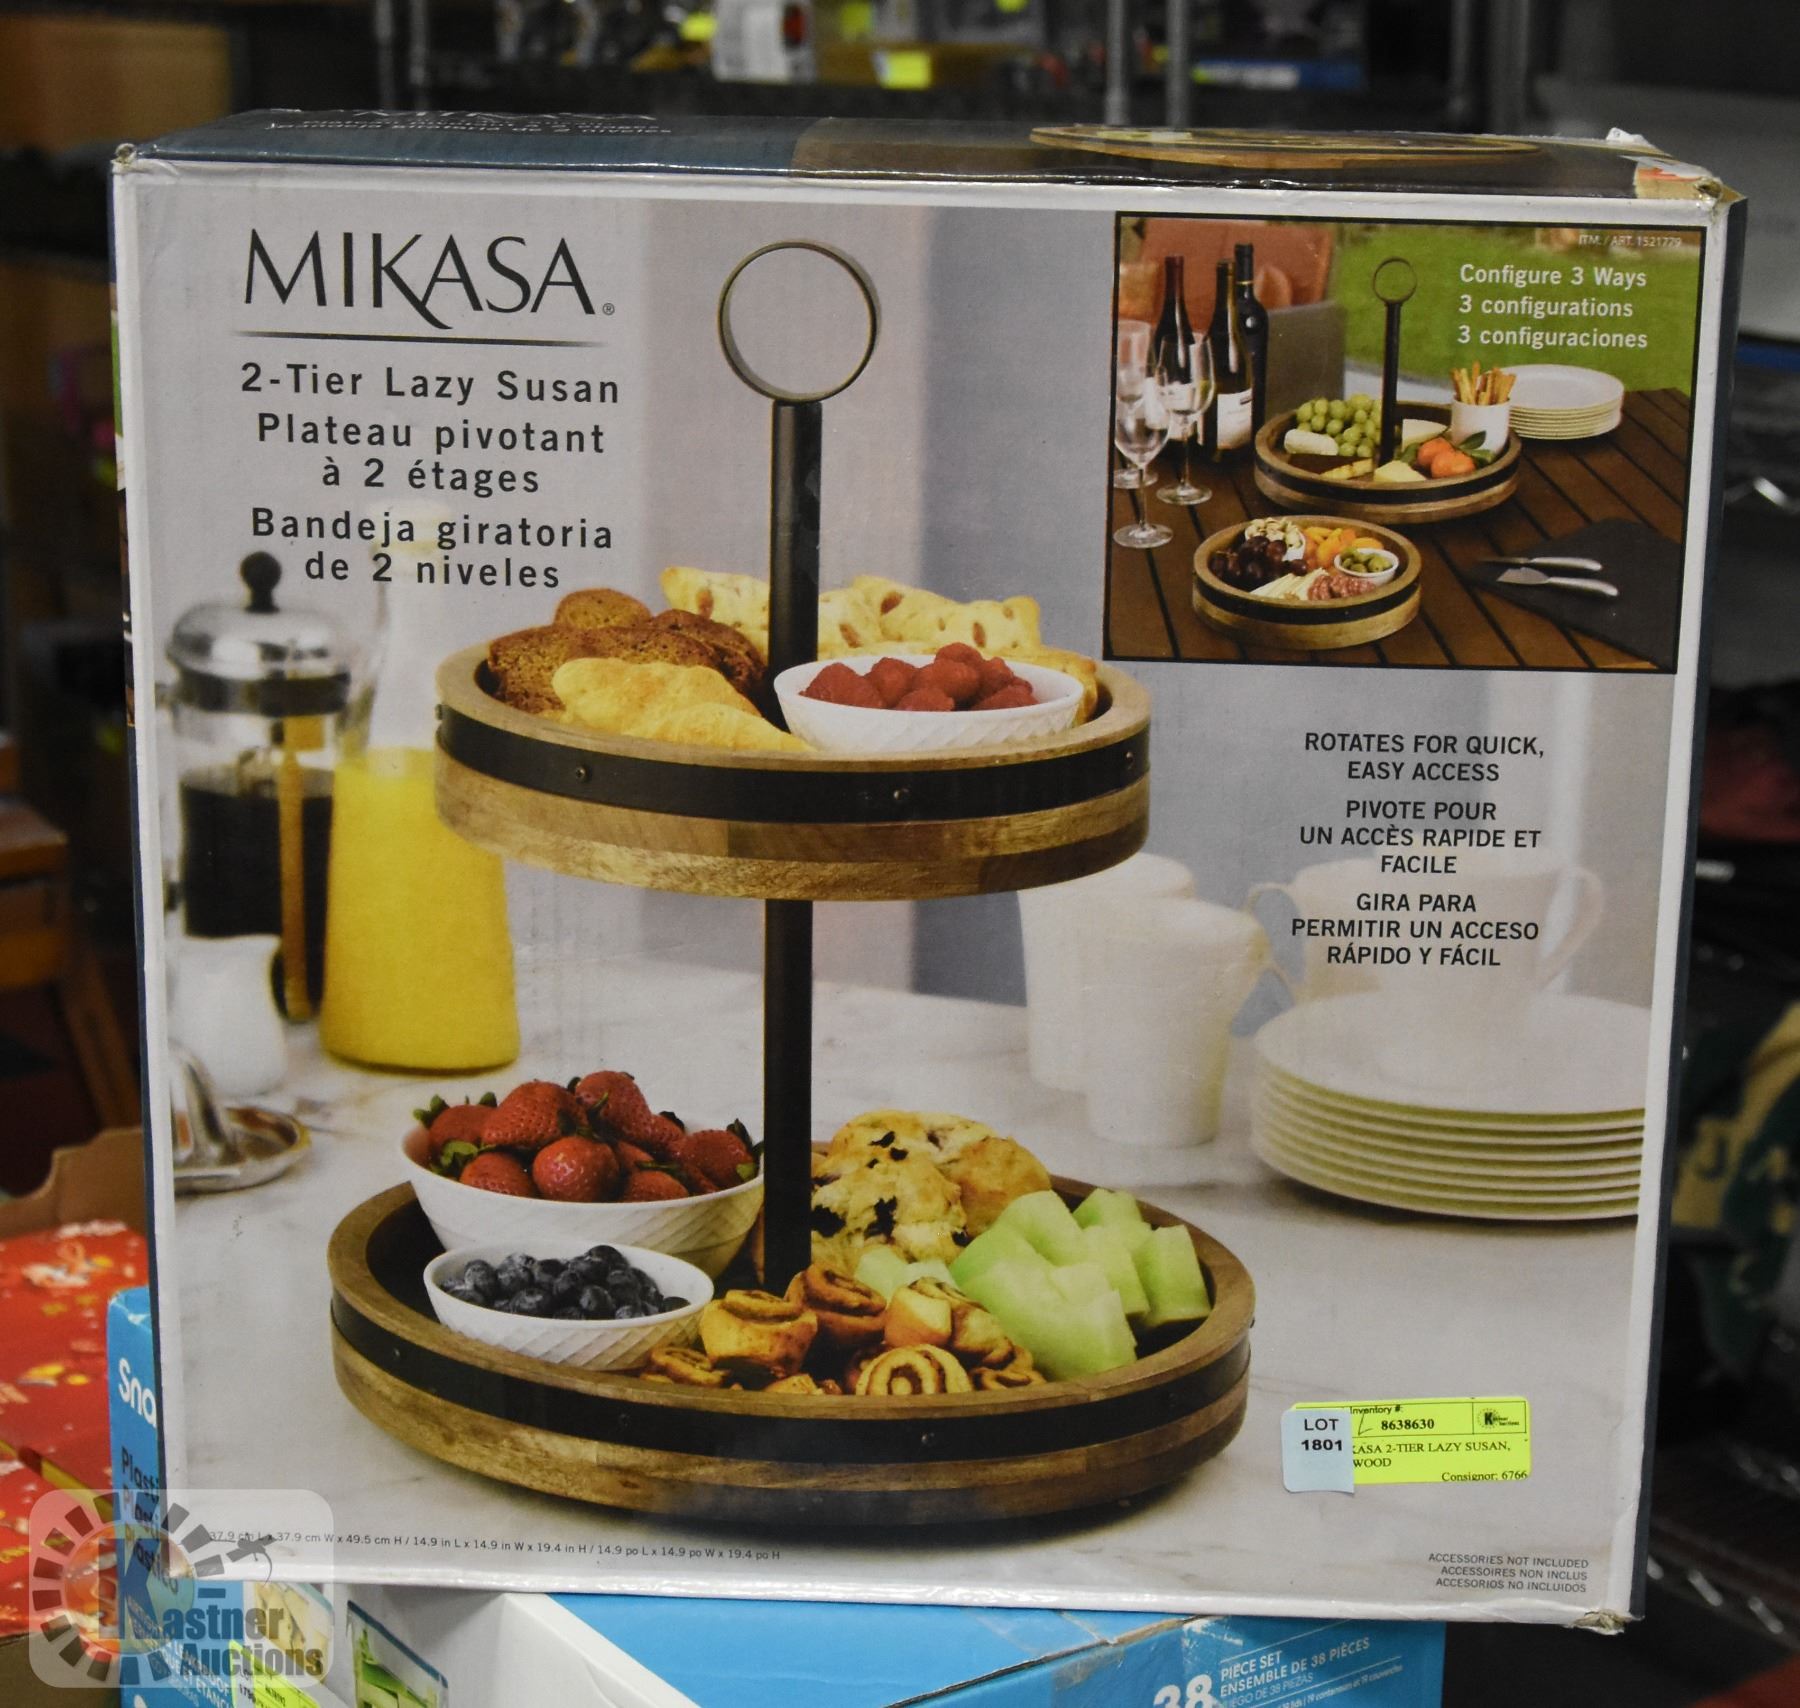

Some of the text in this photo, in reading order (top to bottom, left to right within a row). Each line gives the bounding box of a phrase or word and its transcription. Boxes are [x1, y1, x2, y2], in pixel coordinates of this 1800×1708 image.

[244, 229, 597, 330] MIKASA
[1460, 264, 1647, 289] Configure 3 Ways
[1459, 294, 1634, 319] 3 configurations
[1458, 325, 1648, 350] 3 configuraciones
[241, 363, 620, 404] 2-Tier Lazy Susan
[258, 414, 605, 455] Plateau pivotant
[322, 454, 540, 498] à 2 étages
[252, 508, 613, 551] Bandeja giratoria
[305, 551, 560, 588] de 2 niveles
[1305, 733, 1545, 757] ROTATES FOR QUICK,
[1348, 762, 1499, 781] EASY ACCESS
[1346, 801, 1496, 820] PIVOTE POUR
[1300, 824, 1541, 847] UN ACCÈS RAPIDE ET
[1381, 856, 1456, 873] FACILE
[1357, 893, 1476, 911] GIRA PARA
[1292, 919, 1539, 940] PERMITIR UN ACCESO
[1327, 942, 1500, 965] RÁPIDO Y FÁCIL
[1304, 1418, 1339, 1431] LOT
[1381, 1419, 1435, 1430] 8638630
[1301, 1439, 1343, 1451] 1801
[1386, 1443, 1424, 1453] 2-TIER
[1428, 1442, 1460, 1452] LAZY
[1465, 1441, 1511, 1452] SUSAN,
[1353, 1458, 1392, 1468] WOOD
[1441, 1471, 1528, 1481] Consignor: 6766
[277, 1532, 301, 1542] 37.9
[324, 1534, 335, 1543] W
[346, 1534, 371, 1544] 49.5
[375, 1536, 390, 1545] cm
[394, 1536, 402, 1545] H
[413, 1536, 438, 1547] 14.9
[441, 1537, 451, 1547] in
[455, 1538, 461, 1547] L
[464, 1540, 470, 1548] x
[474, 1539, 498, 1549] 14.9
[502, 1541, 511, 1550] in
[514, 1541, 525, 1550] W
[527, 1543, 533, 1551] x
[537, 1542, 561, 1552] 19.4
[565, 1543, 574, 1553] in
[578, 1543, 587, 1553] H
[598, 1544, 622, 1555] 14.9
[626, 1547, 639, 1557] po
[642, 1546, 649, 1556] L
[661, 1546, 686, 1557] 14.9
[689, 1549, 702, 1559] po
[705, 1548, 716, 1558] W
[718, 1550, 723, 1558] x
[728, 1548, 752, 1559] 19.4
[755, 1551, 769, 1561] po
[772, 1550, 780, 1560] H
[1429, 1553, 1589, 1569] ACCESSORIES NOT INCLUDED
[1441, 1566, 1588, 1581] ACCESSOIRES NON INCLUS
[1436, 1578, 1587, 1593] ACCESORIOS NO INCLUIDOS
[1220, 1664, 1289, 1698] ENSEMBLE
[1291, 1659, 1308, 1675] DE
[1311, 1652, 1327, 1668] 38
[1221, 1650, 1282, 1682] PIECE SET
